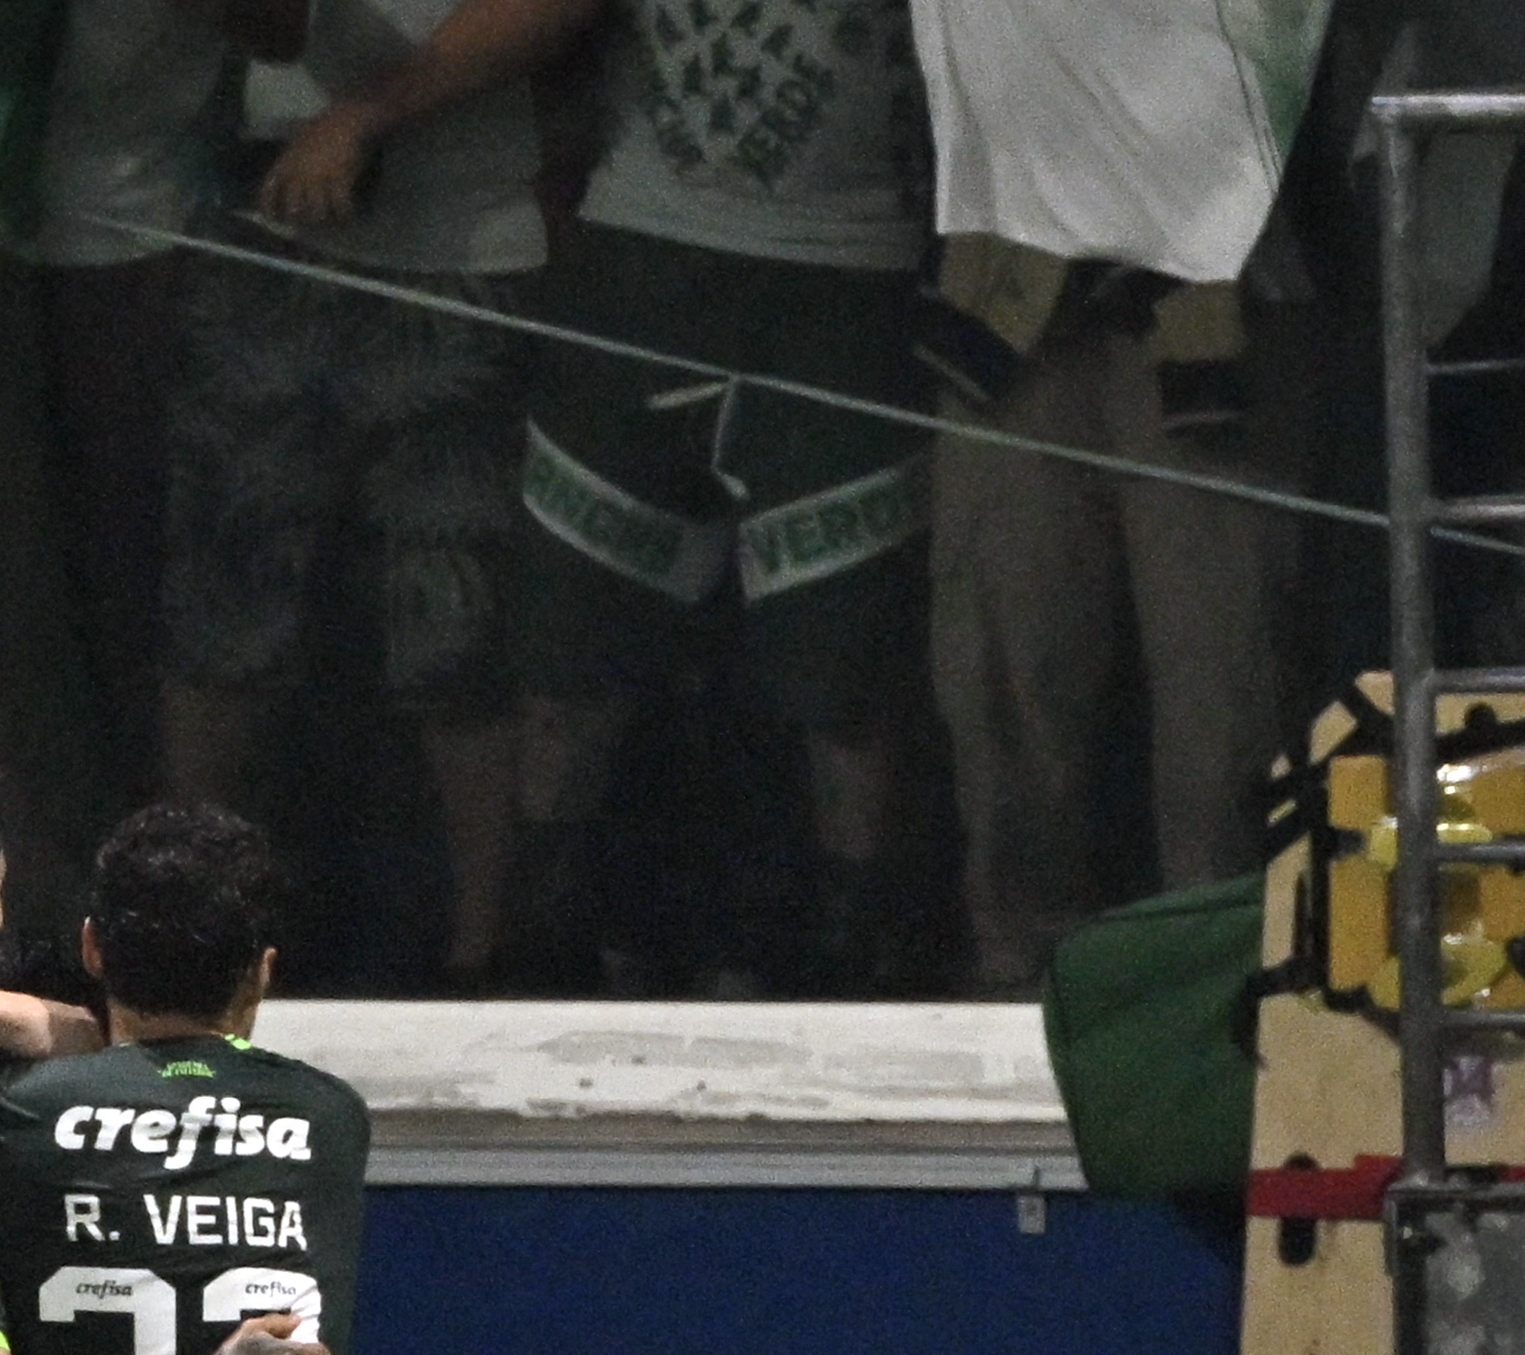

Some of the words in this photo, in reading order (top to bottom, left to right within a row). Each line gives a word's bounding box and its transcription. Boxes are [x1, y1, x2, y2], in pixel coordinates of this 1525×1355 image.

[52, 1095, 314, 1172] crefisa
[63, 1193, 122, 1243] R.
[142, 1193, 309, 1252] VEIGA
[74, 1278, 135, 1300] crefisa
